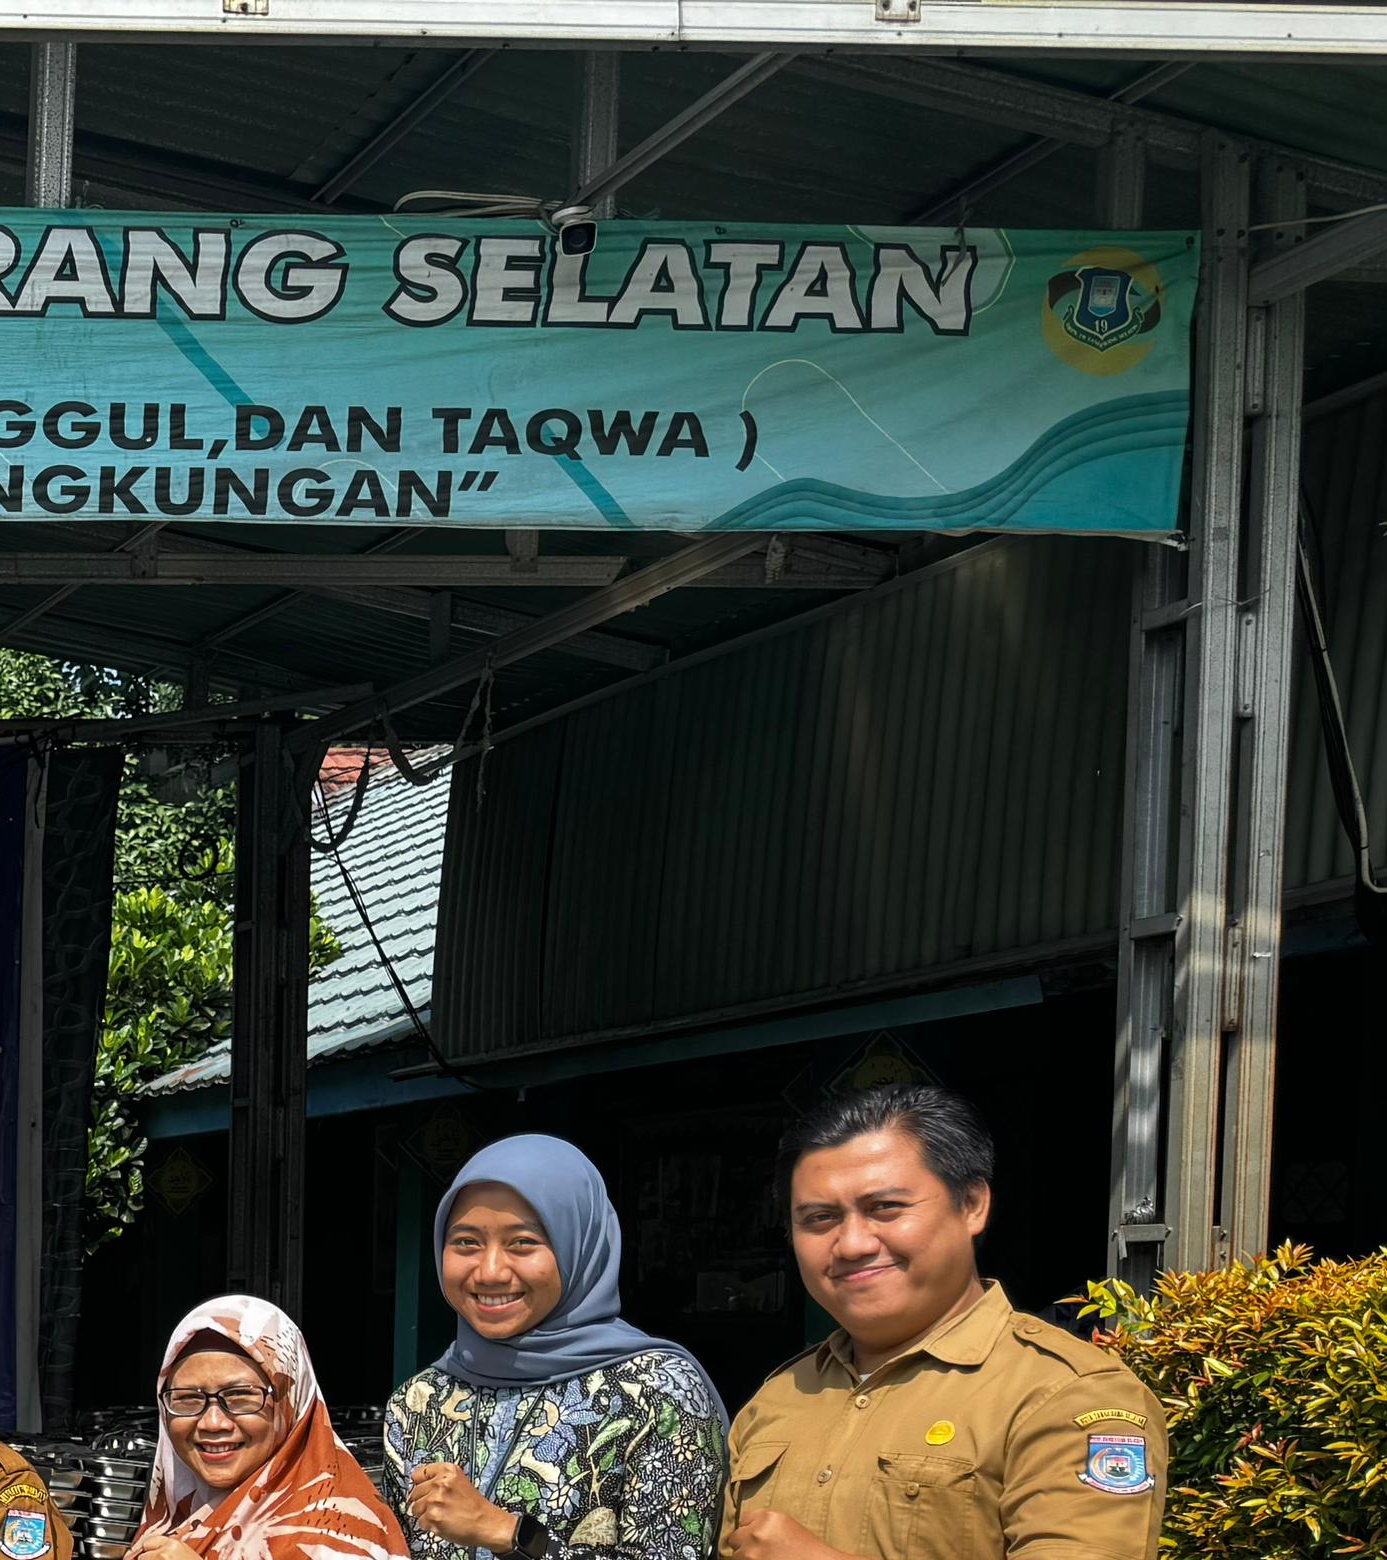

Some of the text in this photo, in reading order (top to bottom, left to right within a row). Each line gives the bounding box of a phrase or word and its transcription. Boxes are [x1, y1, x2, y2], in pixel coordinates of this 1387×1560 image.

[382, 231, 980, 335] SELATAN
[1094, 319, 1108, 333] 19
[432, 407, 711, 461] TAQWA
